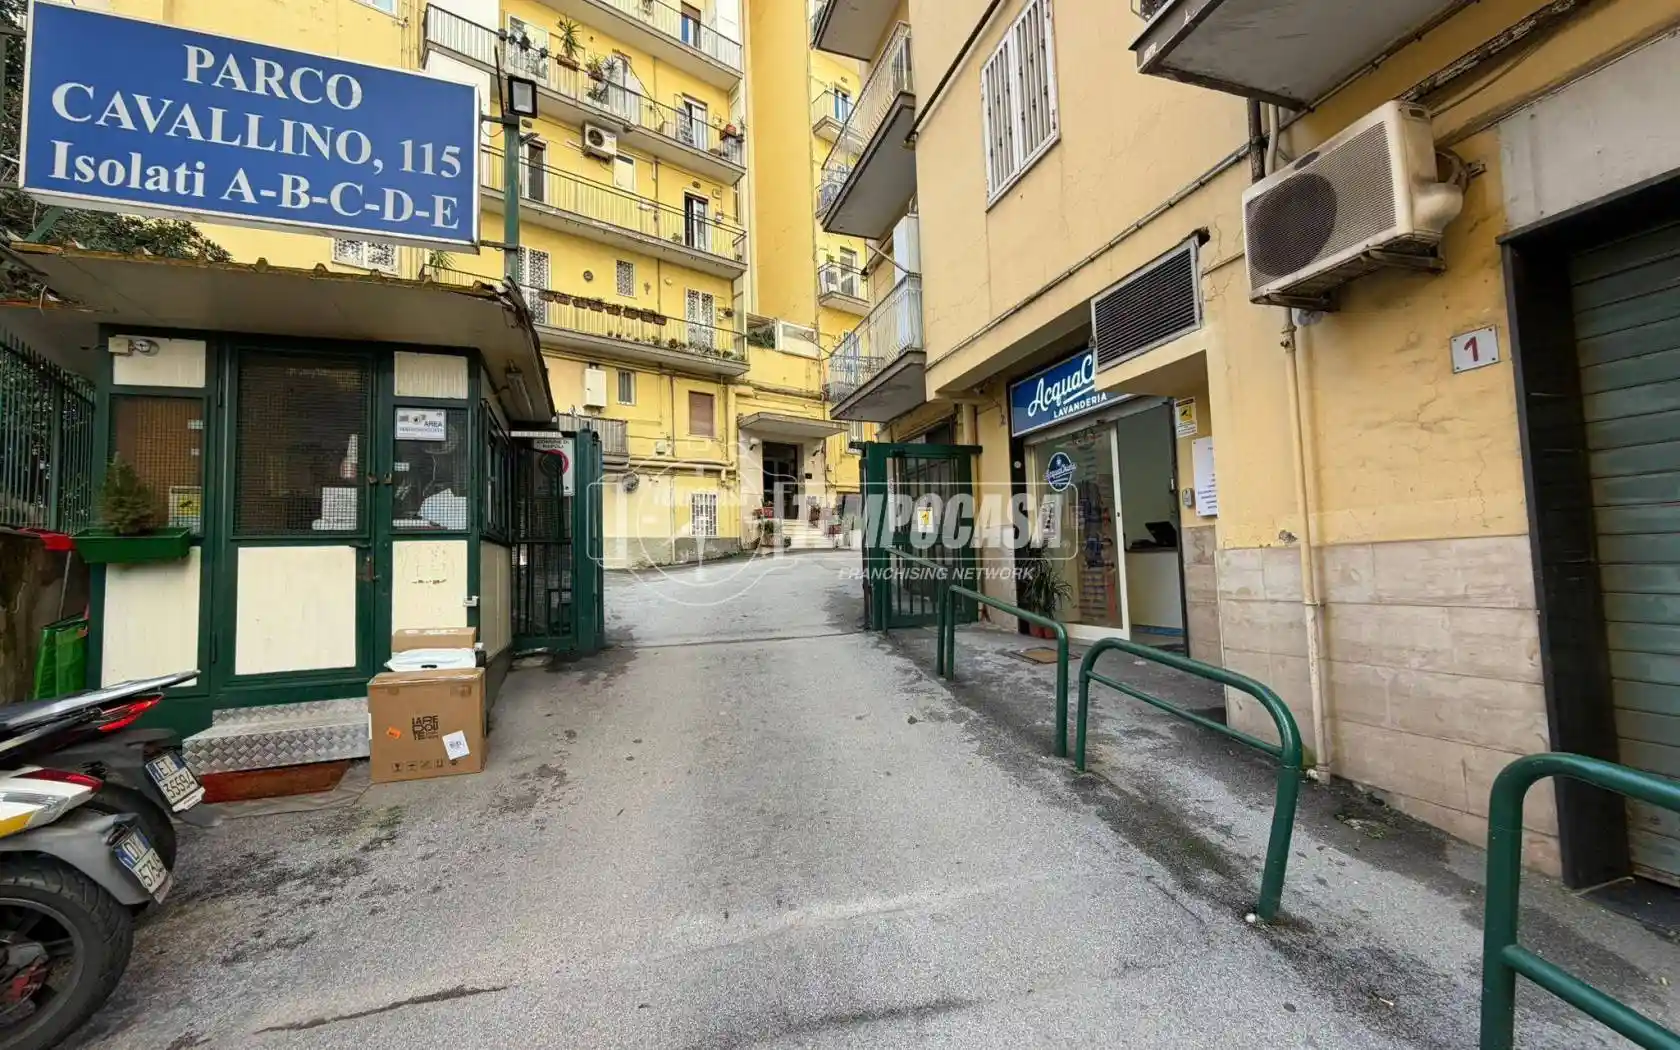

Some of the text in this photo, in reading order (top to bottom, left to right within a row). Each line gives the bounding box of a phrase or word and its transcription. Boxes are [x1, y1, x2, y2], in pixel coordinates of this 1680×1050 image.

[183, 44, 363, 111] PARCO
[51, 82, 461, 178] CAVALLINO, 115
[48, 139, 459, 230] Isolati A-B-C-D-E
[1463, 336, 1479, 362] 1
[1027, 353, 1096, 418] AcquaC
[1053, 391, 1108, 419] LAVANDERIA
